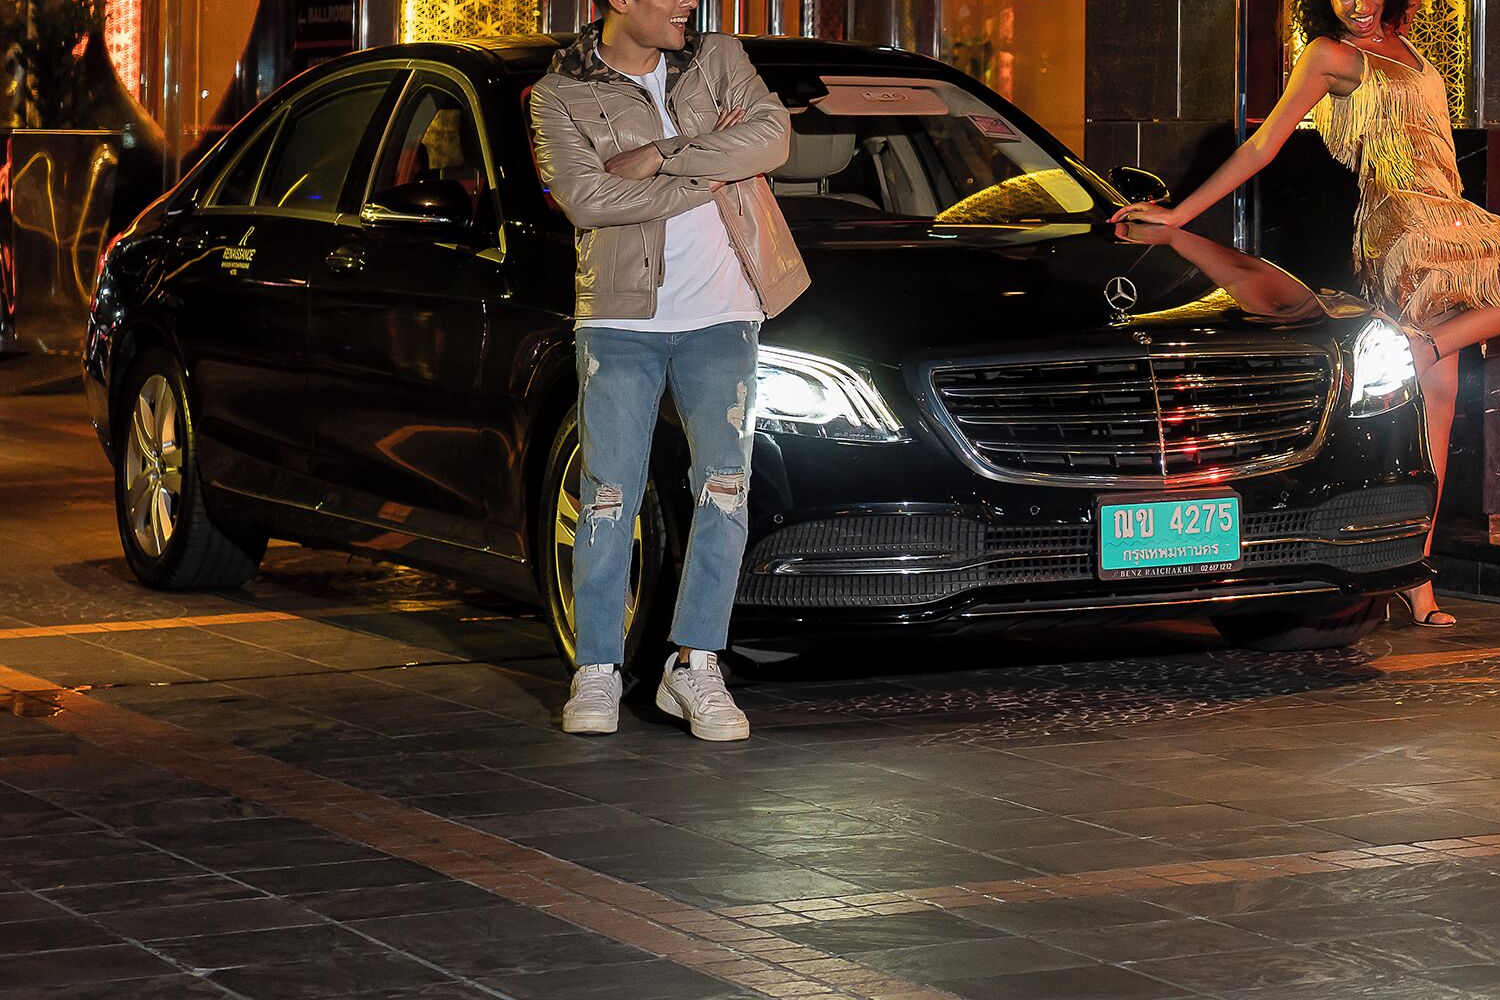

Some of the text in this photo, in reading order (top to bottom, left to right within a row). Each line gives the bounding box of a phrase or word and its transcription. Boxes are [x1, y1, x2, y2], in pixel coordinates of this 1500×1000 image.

[1169, 502, 1233, 535] 4275
[1123, 543, 1219, 566] กรุงเทพมหานคร
[1120, 569, 1142, 578] BENZ
